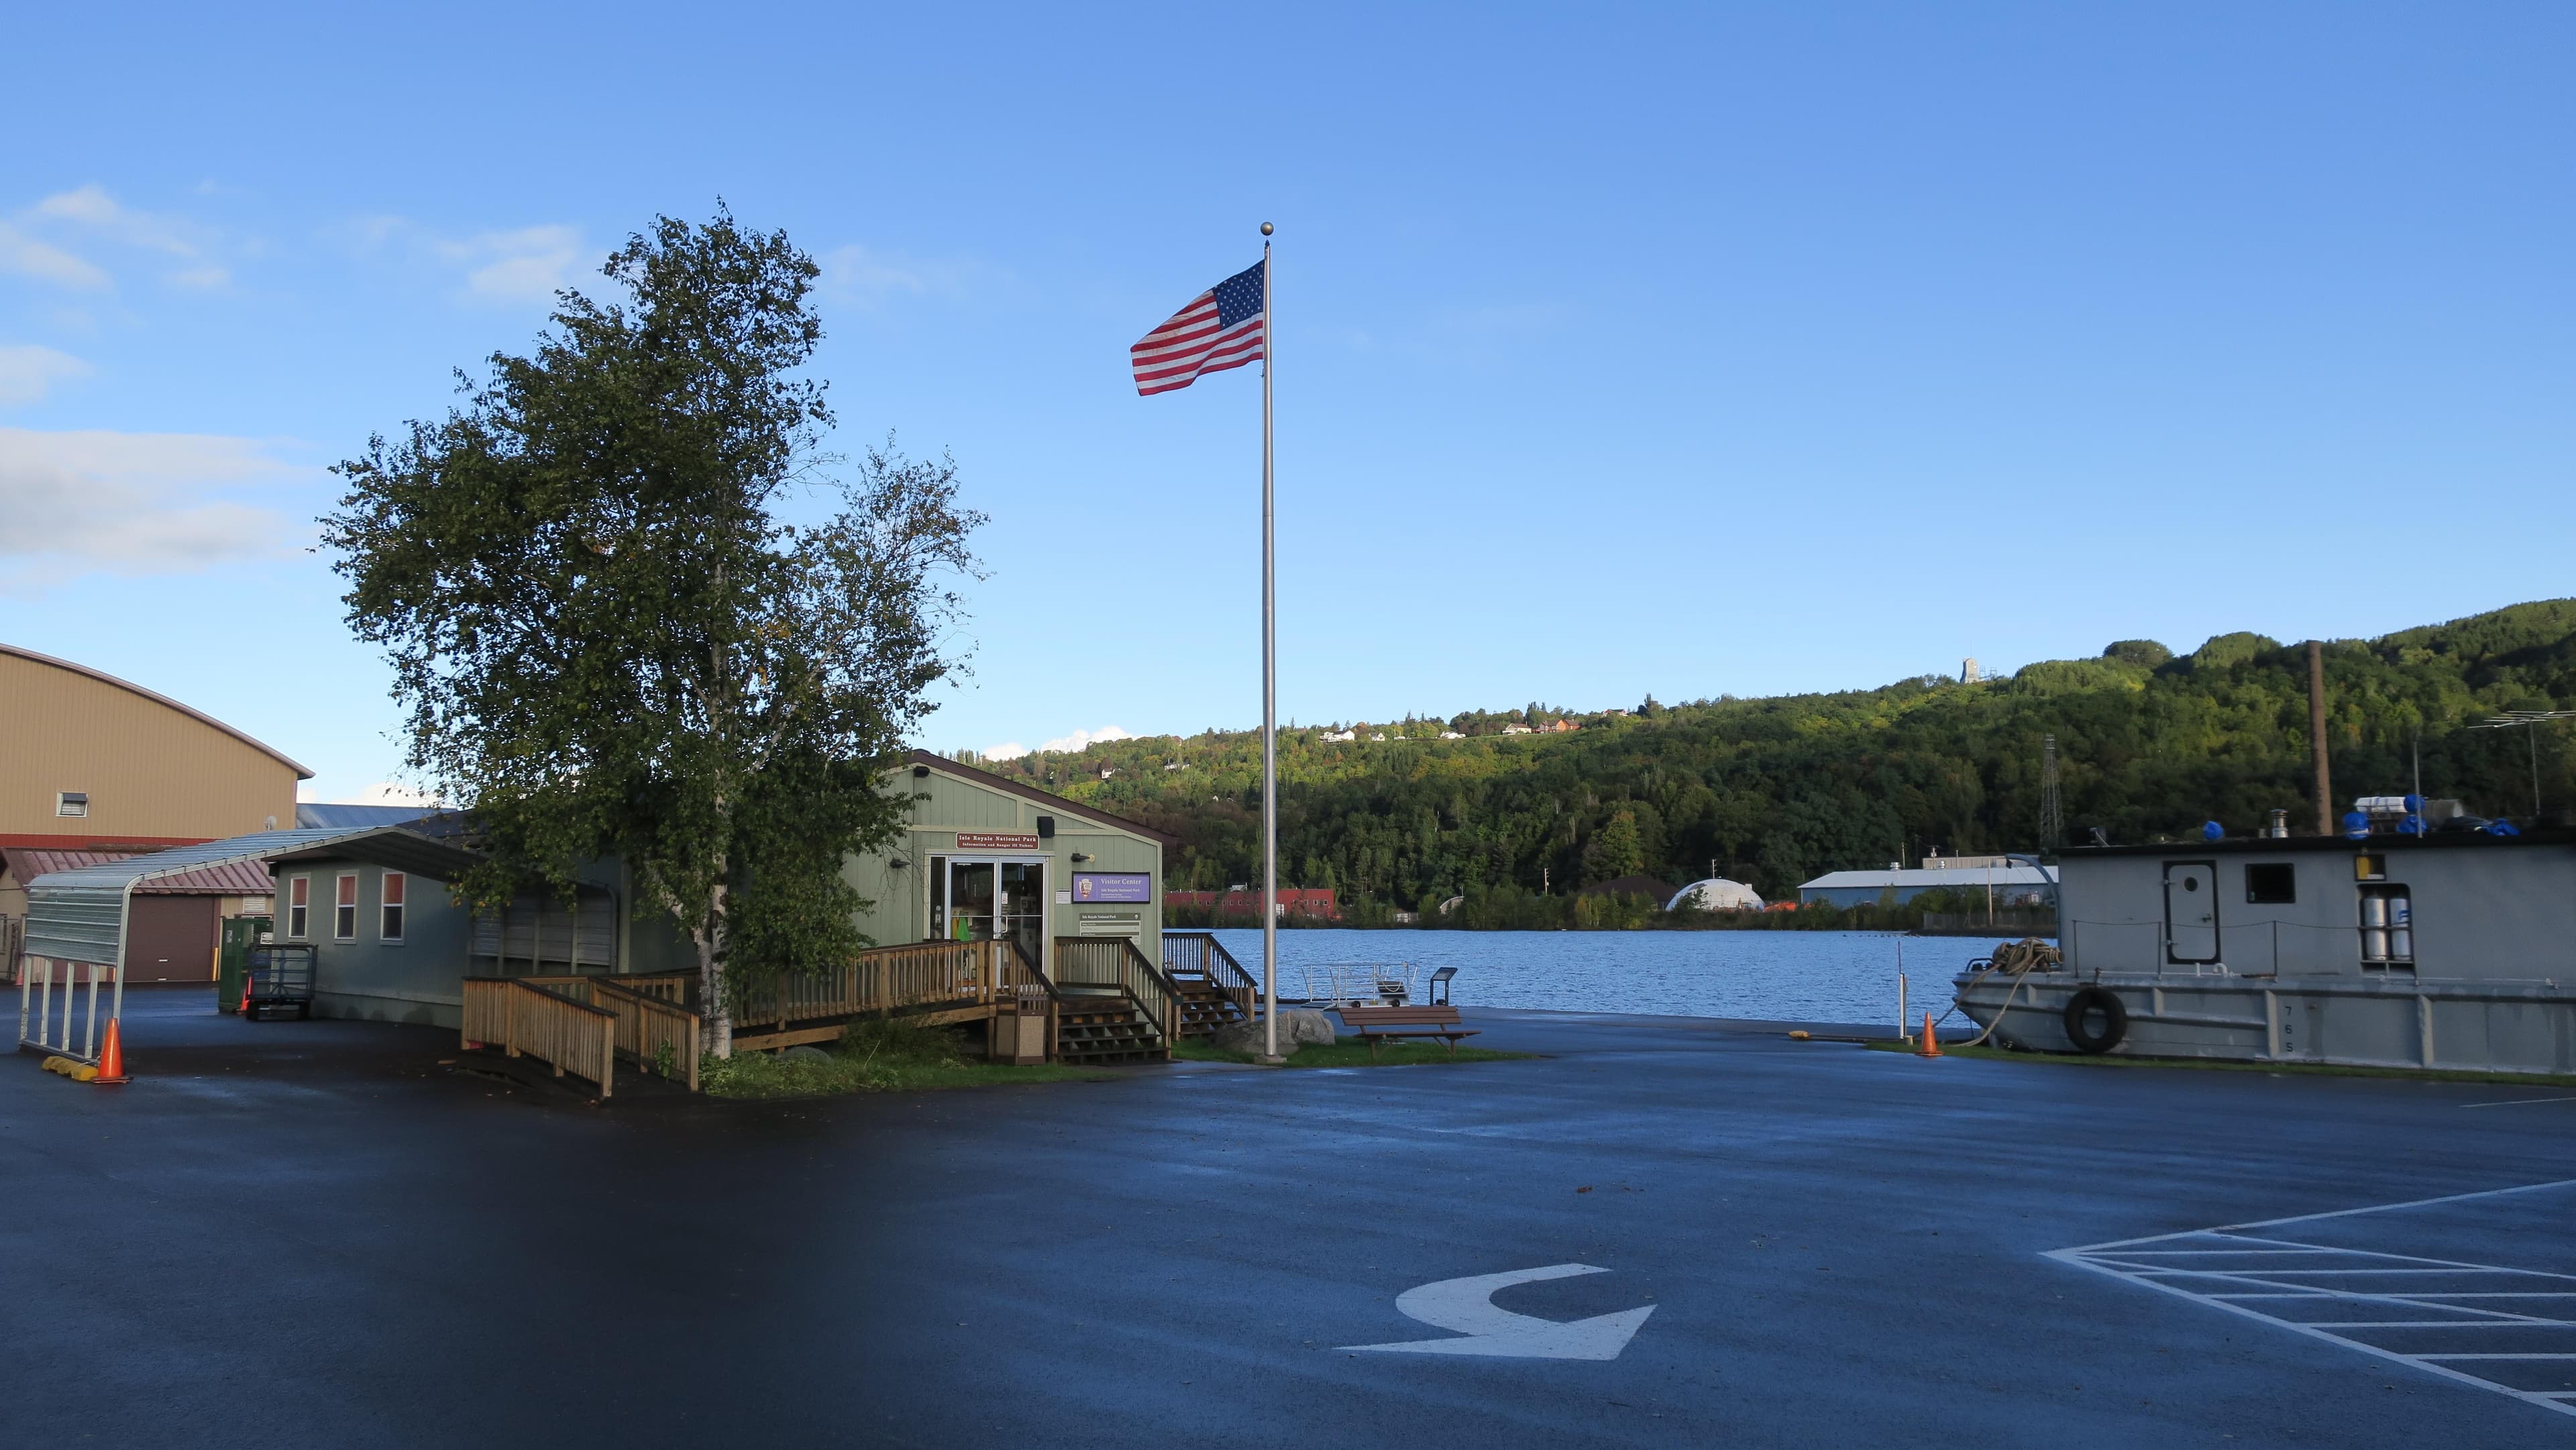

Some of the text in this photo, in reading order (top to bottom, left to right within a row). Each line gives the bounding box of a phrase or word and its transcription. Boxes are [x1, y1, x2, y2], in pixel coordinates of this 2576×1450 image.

[2285, 1006, 2292, 1016] 7
[2286, 1025, 2292, 1034] 6
[2286, 1042, 2293, 1052] 5
